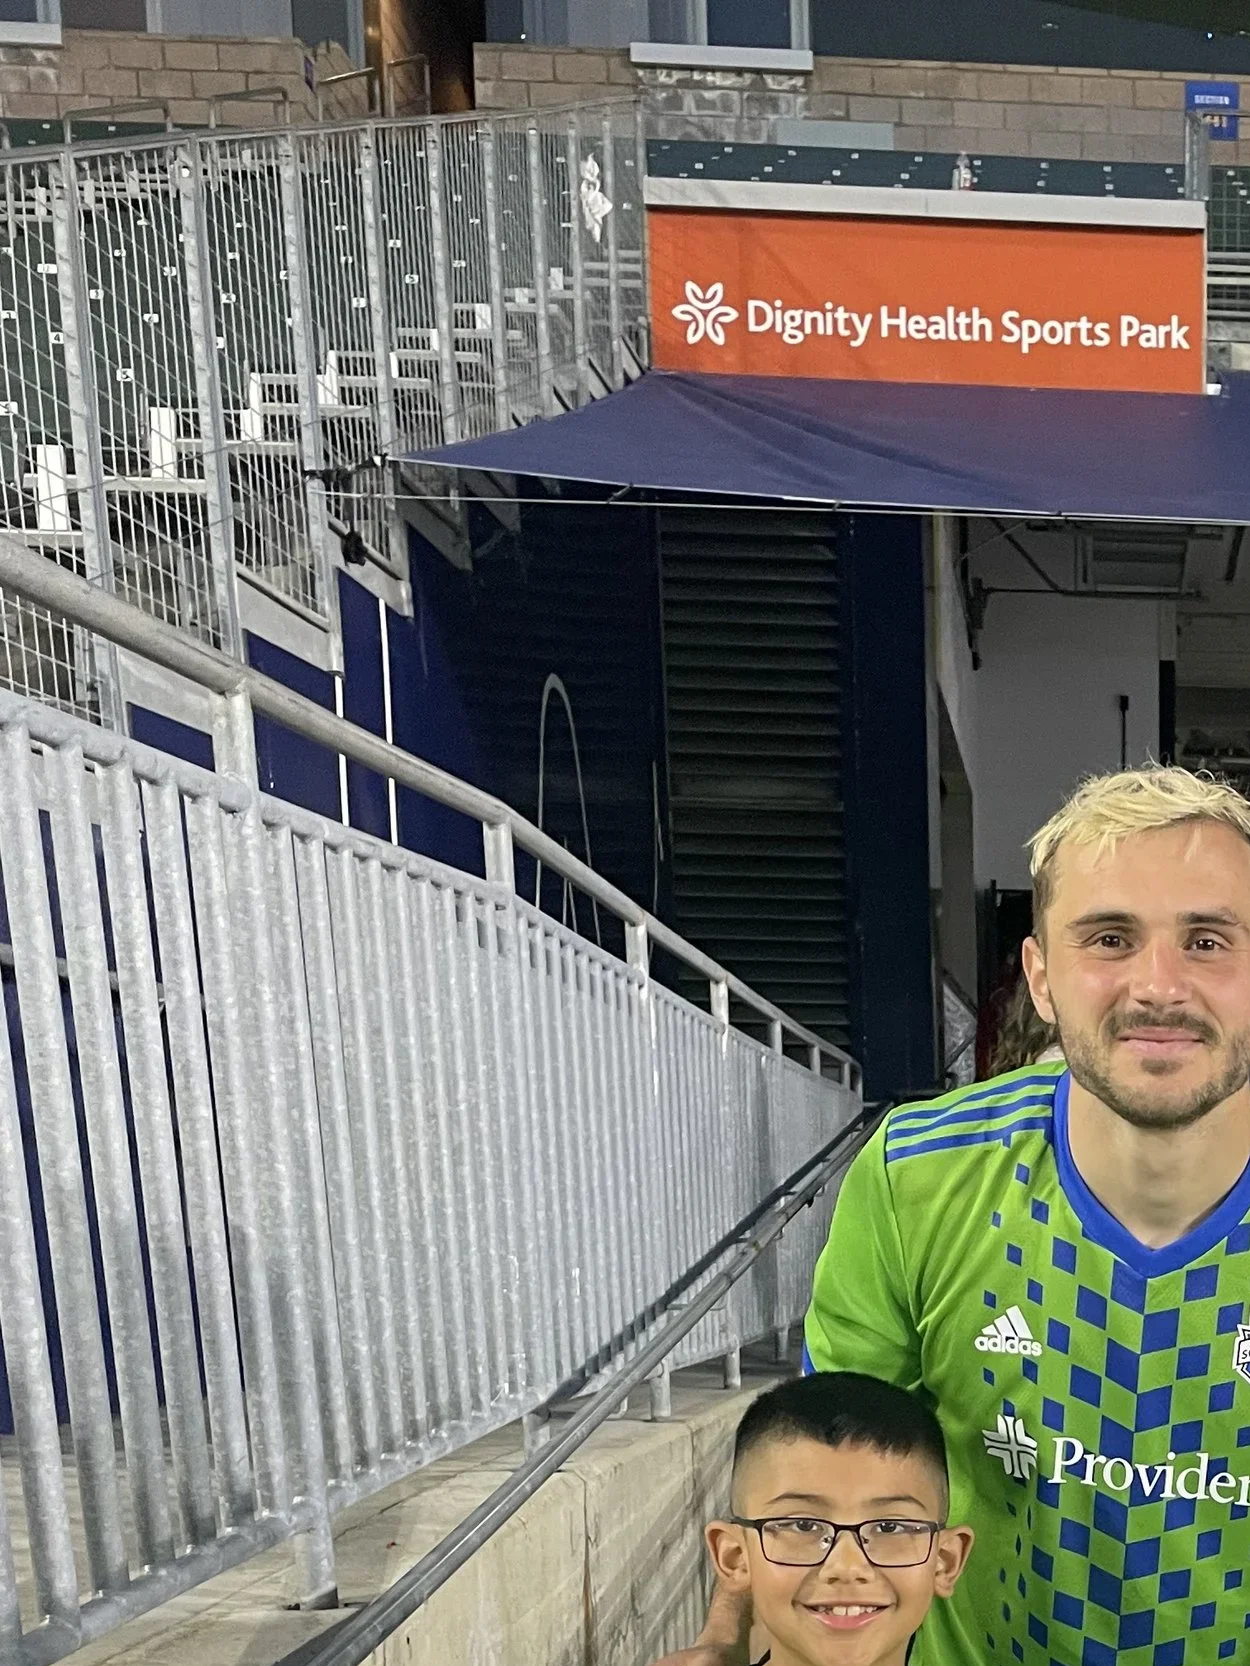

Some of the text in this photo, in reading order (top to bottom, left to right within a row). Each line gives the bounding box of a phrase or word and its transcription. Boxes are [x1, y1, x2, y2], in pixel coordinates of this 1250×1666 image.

[747, 299, 1191, 354] Dignity Health Sports Park
[974, 1333, 1043, 1357] adidas
